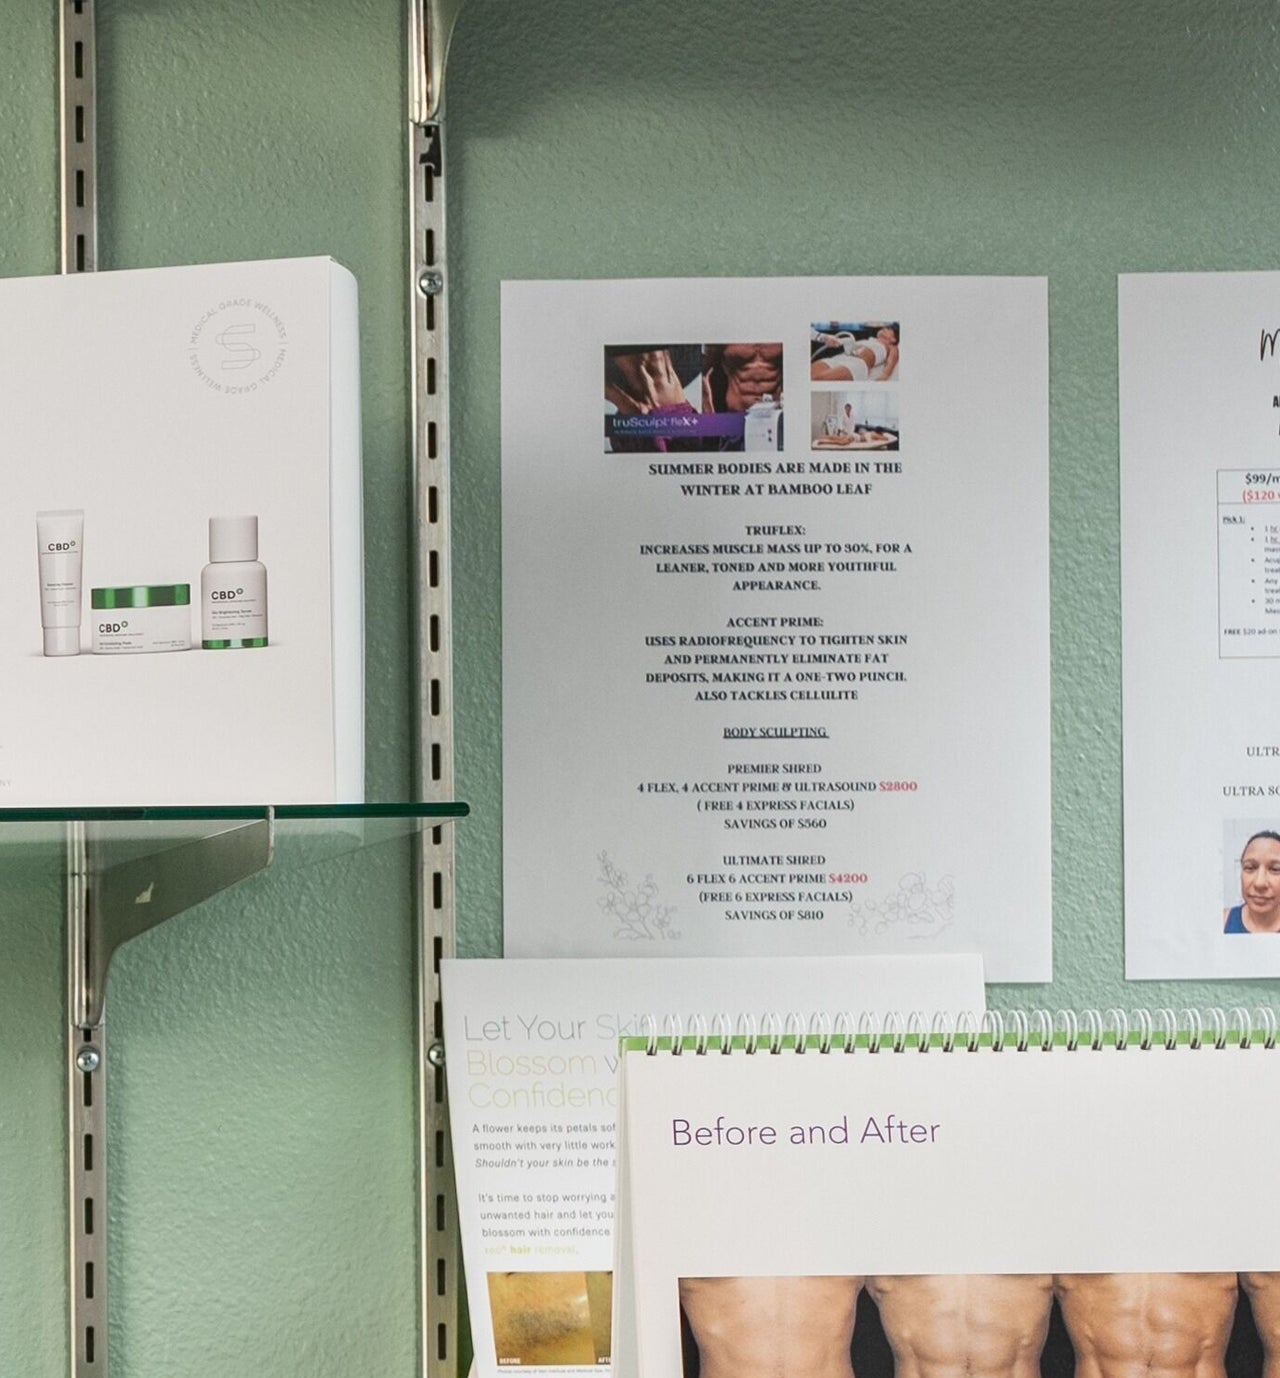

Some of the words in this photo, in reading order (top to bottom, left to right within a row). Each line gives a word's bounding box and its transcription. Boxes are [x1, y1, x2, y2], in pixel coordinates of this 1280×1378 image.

[649, 462, 714, 476] SUMMER
[718, 463, 772, 475] BODIES
[776, 462, 805, 474] ARE
[809, 462, 851, 473] MADE
[855, 462, 870, 472] IN
[873, 461, 903, 472] THE
[681, 484, 741, 496] WINTER
[745, 484, 764, 495] AT
[768, 484, 833, 495] BAMBOO
[837, 483, 872, 494] LEAF
[745, 525, 806, 536] TRUFLEX:
[726, 617, 777, 628] ACCENT
[781, 617, 823, 628] PRIME:
[695, 690, 727, 700] ALSO
[731, 690, 788, 700] TACKLES
[791, 690, 858, 700] CELLULITE
[723, 727, 756, 738] BODY
[760, 726, 826, 738] SCULPTING
[727, 764, 780, 774] PREMIER
[782, 764, 822, 774] SHRED
[723, 855, 784, 865] ULTIMATE
[786, 855, 826, 865] SHRED
[464, 1016, 511, 1042] Let
[517, 1014, 587, 1041] Your
[467, 1049, 596, 1076] Blossom
[672, 1118, 777, 1146] Before
[790, 1116, 849, 1145] and
[860, 1115, 940, 1143] After
